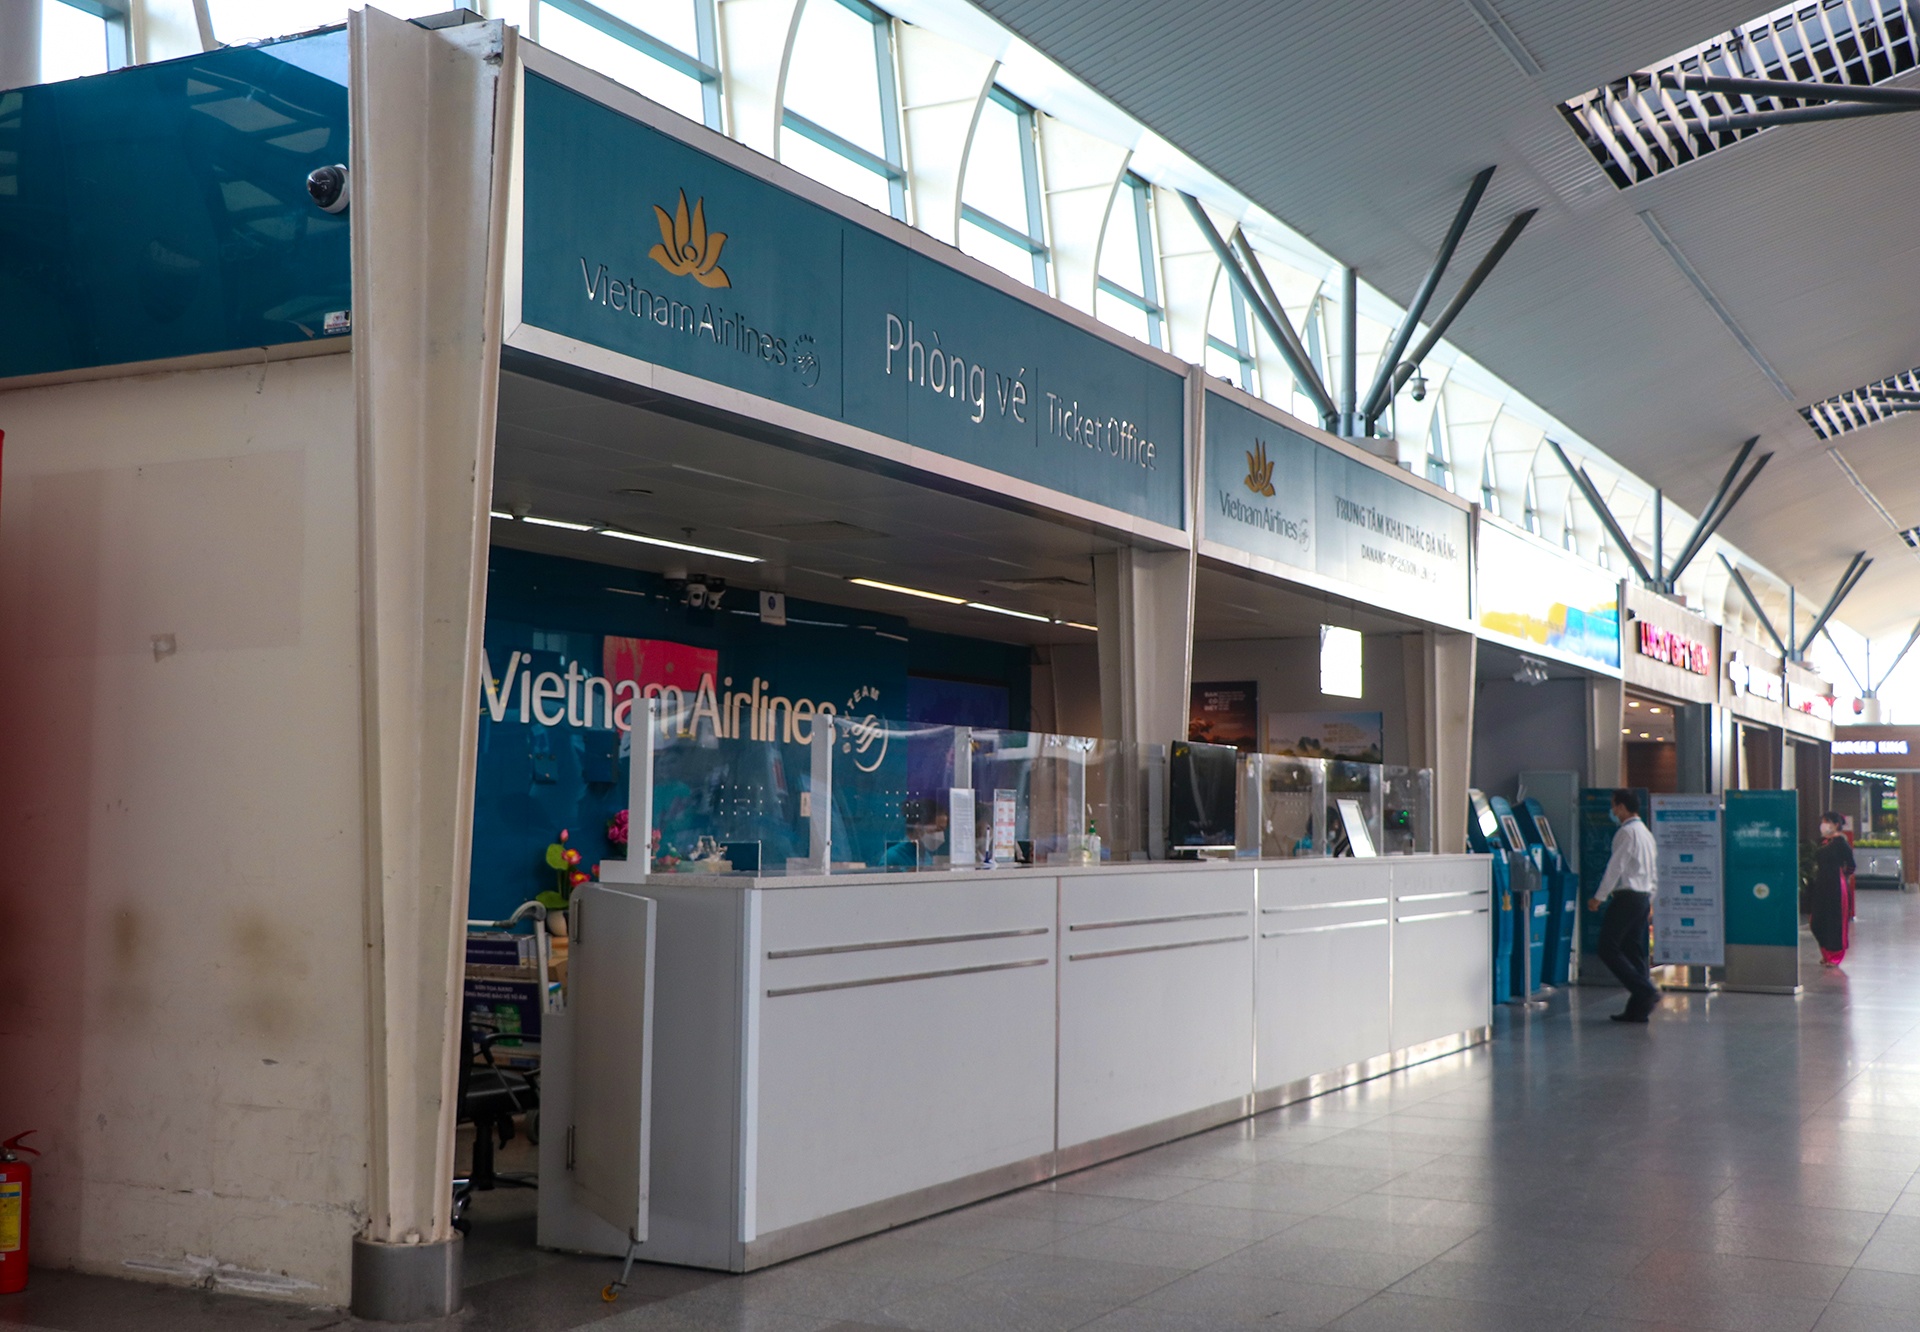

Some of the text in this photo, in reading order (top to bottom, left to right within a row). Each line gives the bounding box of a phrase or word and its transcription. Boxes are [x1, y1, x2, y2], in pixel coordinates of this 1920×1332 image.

[580, 256, 788, 367] Vietnam Airlines
[885, 312, 1027, 424] Phòng vé
[1046, 391, 1157, 471] Ticket Office
[1218, 489, 1263, 530] Vietnam
[1262, 506, 1298, 541] Airlines
[1334, 495, 1366, 528] TRUNG
[1366, 506, 1385, 536] TÂM
[1385, 516, 1405, 544] KHAI
[1404, 524, 1425, 551] THÁC
[480, 647, 685, 735] Vietnam
